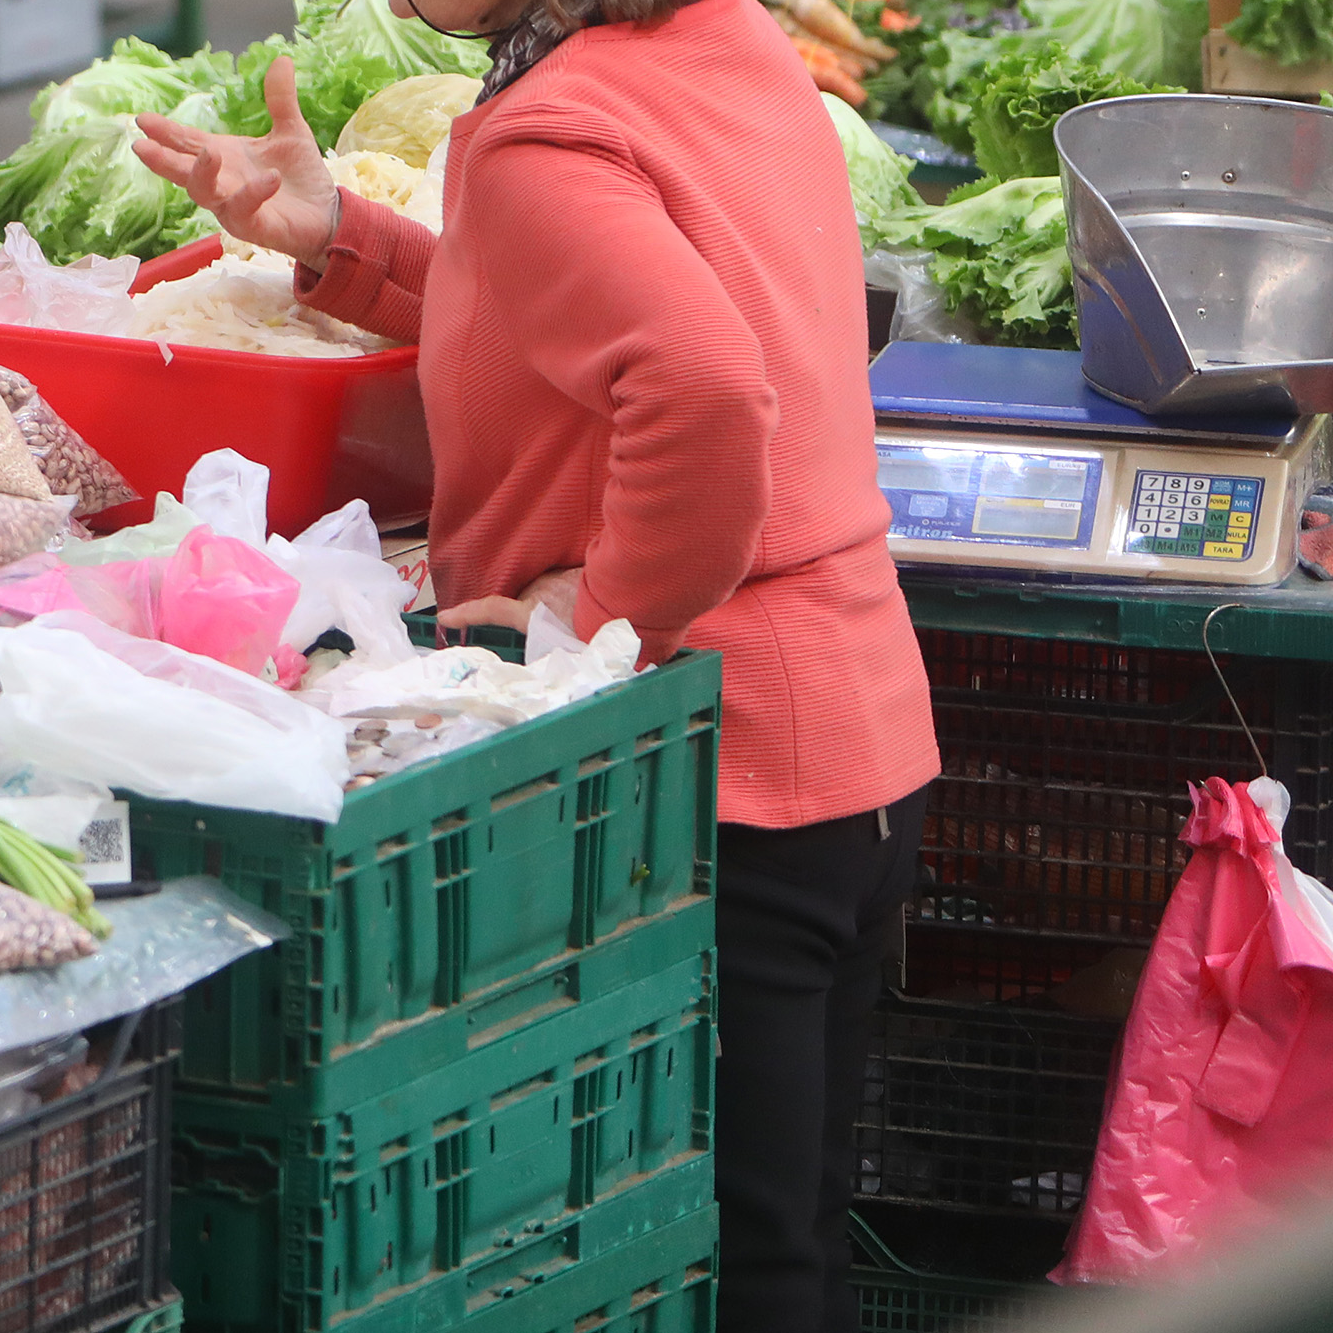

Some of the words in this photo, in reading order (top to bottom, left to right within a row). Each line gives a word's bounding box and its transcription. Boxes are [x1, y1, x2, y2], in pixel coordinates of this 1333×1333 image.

[1148, 477, 1158, 487] 7
[1171, 479, 1181, 489] 8
[1194, 480, 1204, 490] 9
[1145, 493, 1155, 503] 4
[1168, 494, 1178, 504] 5
[1191, 496, 1201, 505] 6
[1145, 509, 1151, 518] 1
[1165, 510, 1176, 520] 2
[1188, 511, 1199, 521] 3
[1211, 513, 1223, 521] M
[1235, 515, 1244, 523] C
[889, 523, 954, 539] igitron
[1139, 523, 1150, 533] 0
[1183, 527, 1199, 536] M1
[1207, 529, 1223, 538] M2
[1157, 541, 1173, 550] M4
[1180, 543, 1197, 552] M5
